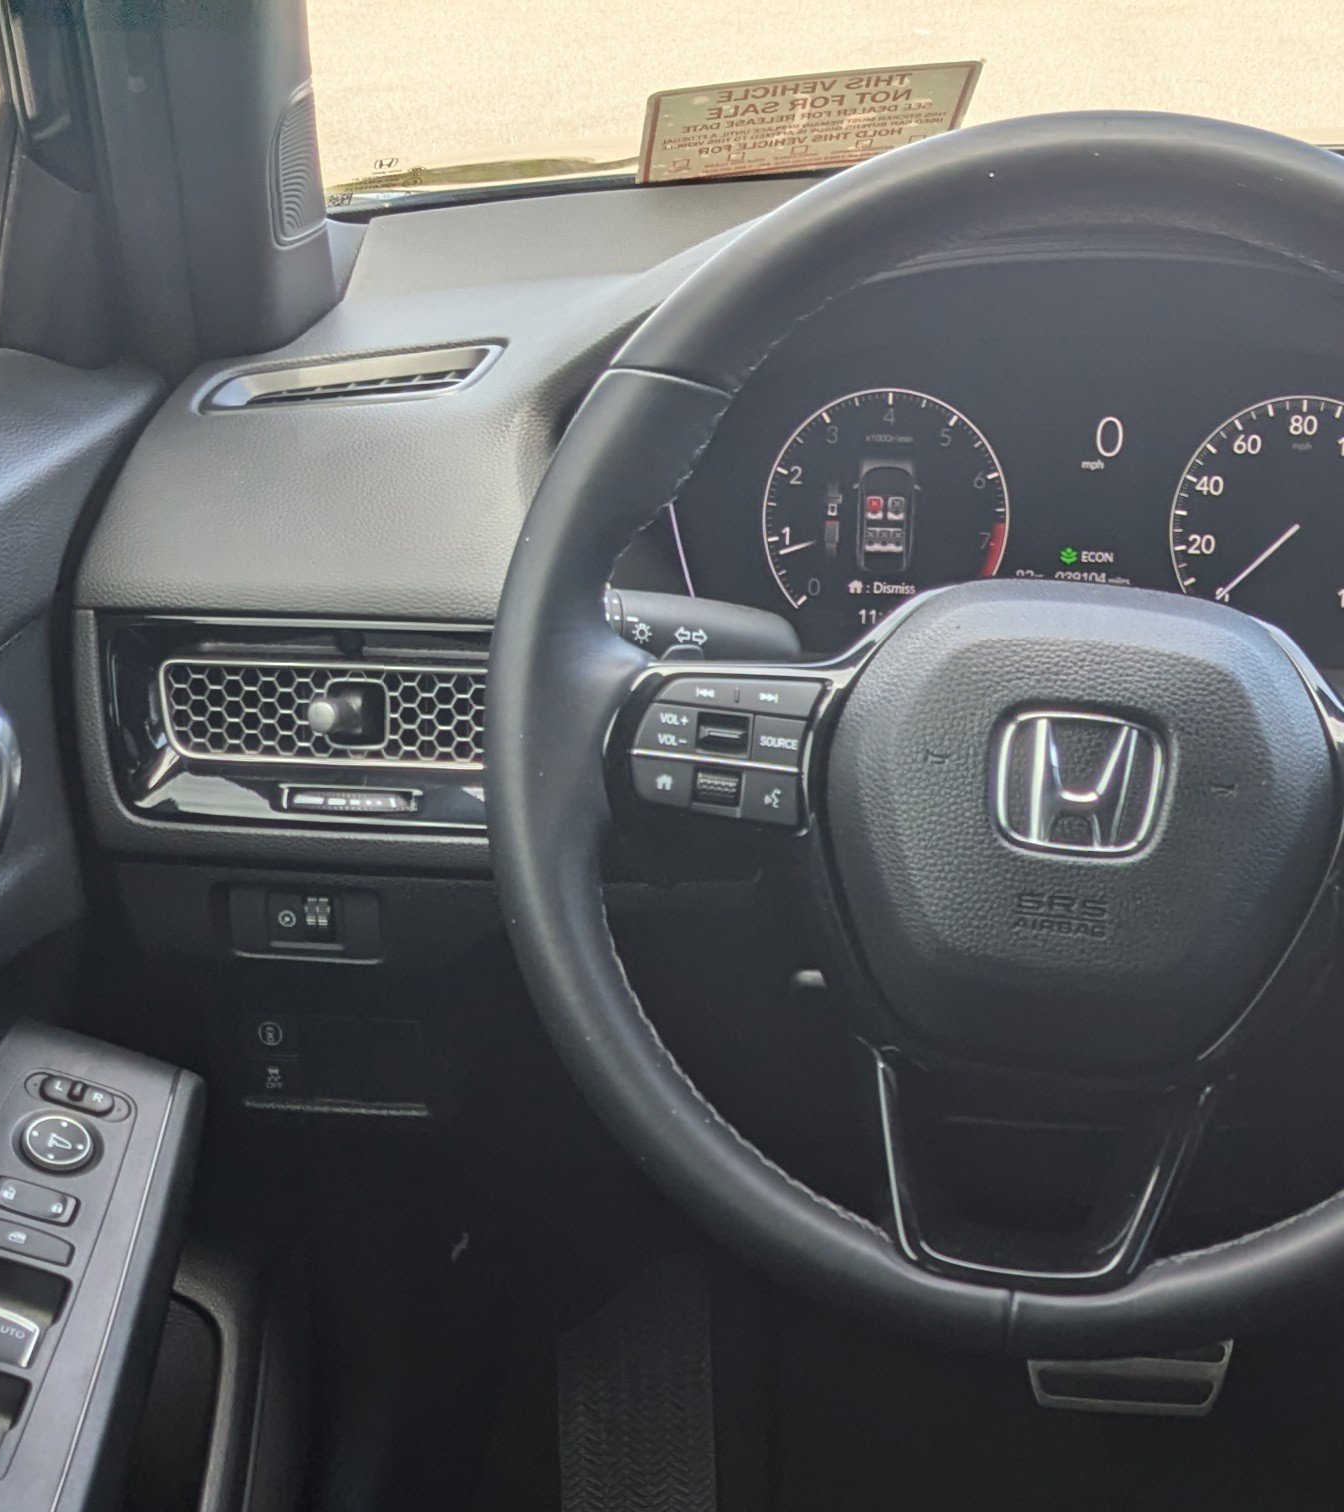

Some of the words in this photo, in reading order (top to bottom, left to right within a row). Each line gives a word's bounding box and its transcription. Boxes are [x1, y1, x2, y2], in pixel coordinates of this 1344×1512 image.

[883, 408, 896, 425] 4
[826, 426, 838, 444] 3
[1289, 416, 1318, 436] 80
[940, 428, 951, 446] 5
[1096, 416, 1123, 457] 0
[1233, 434, 1262, 454] 60
[789, 467, 802, 485] 2
[974, 470, 986, 488] 6
[1195, 476, 1224, 496] 40
[782, 526, 790, 544] 1
[979, 531, 991, 550] 7
[1188, 534, 1216, 554] 20
[1081, 551, 1114, 562] ECON
[808, 578, 821, 598] 0
[873, 582, 916, 595] Dismiss
[760, 735, 798, 750] SOURCE
[92, 1091, 104, 1104] R
